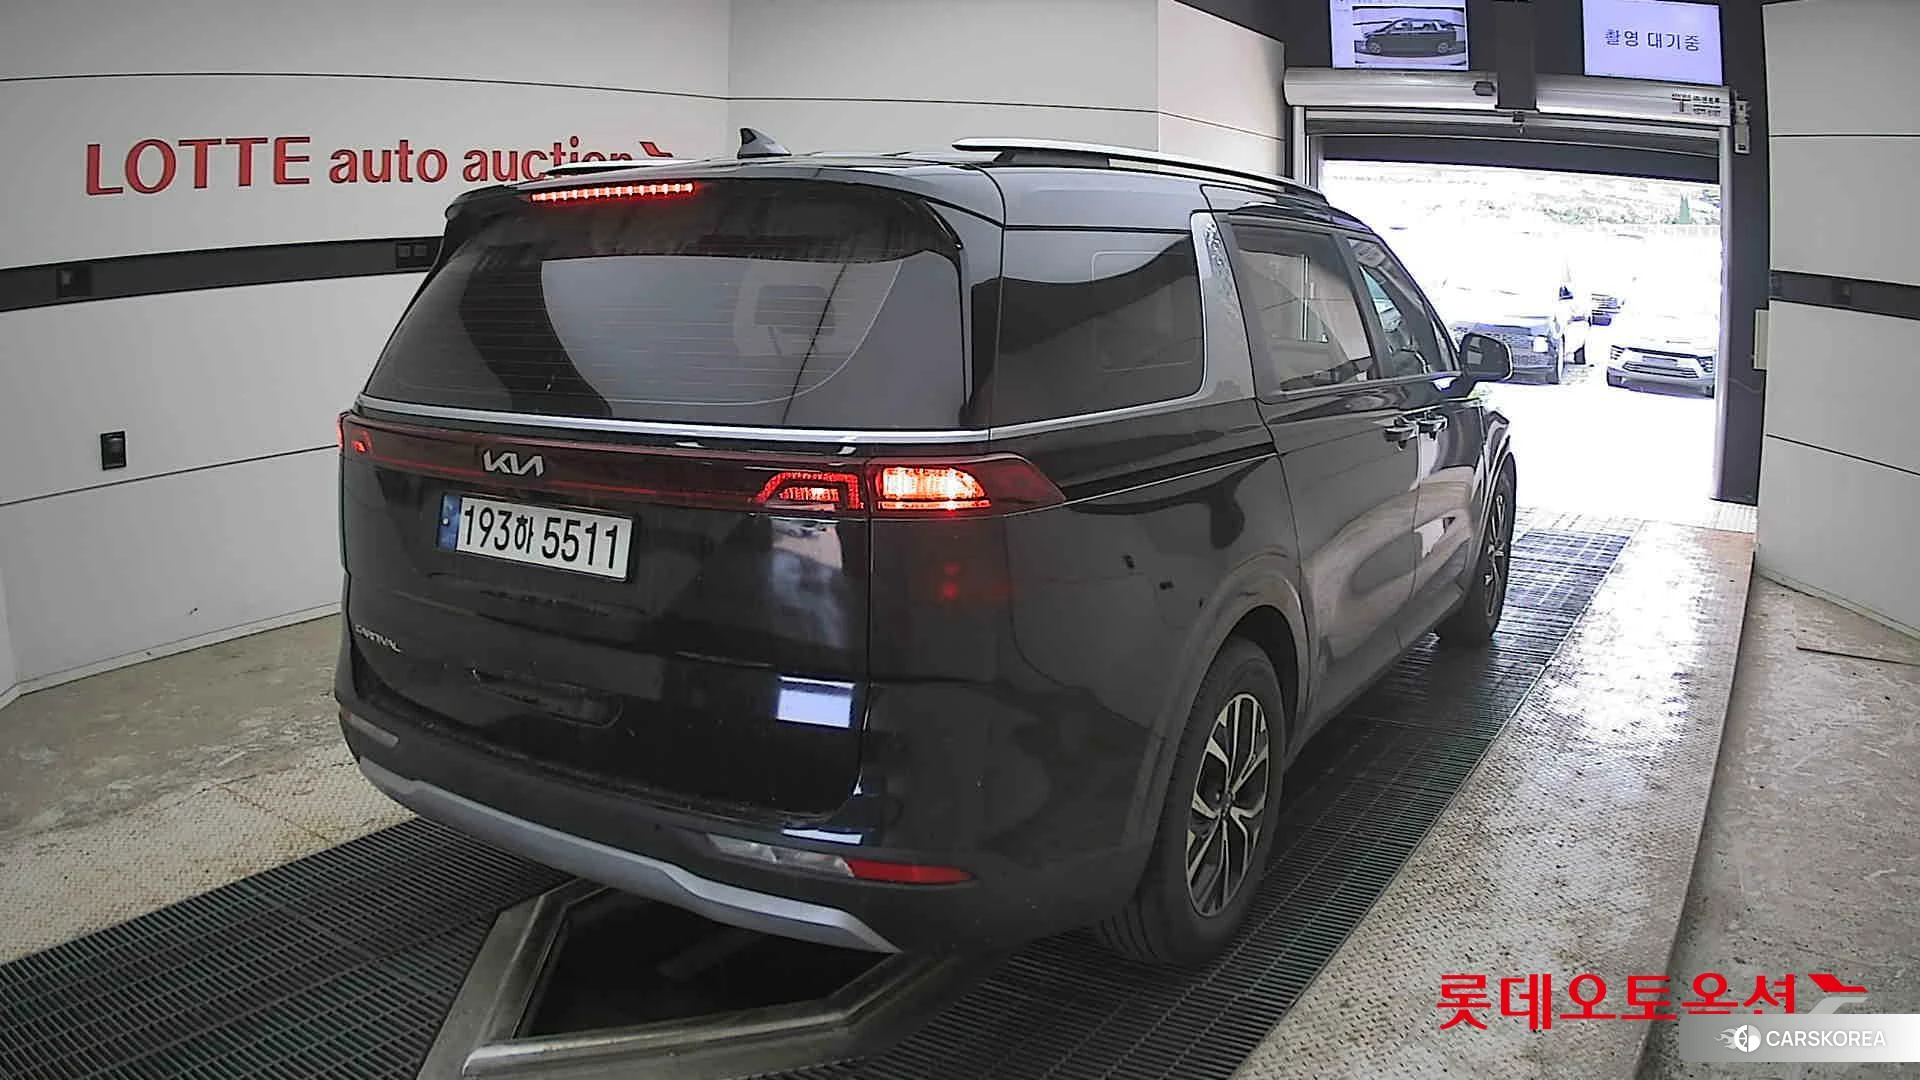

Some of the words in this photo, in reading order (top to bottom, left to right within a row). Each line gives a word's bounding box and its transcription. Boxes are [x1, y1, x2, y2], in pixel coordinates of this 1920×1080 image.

[1647, 32, 1700, 51] 대기중
[86, 136, 310, 195] LOTTE
[329, 139, 448, 183] auto
[462, 136, 632, 182] aucti
[482, 450, 545, 476] KIA
[464, 505, 534, 554] 193하
[541, 517, 619, 569] 5511
